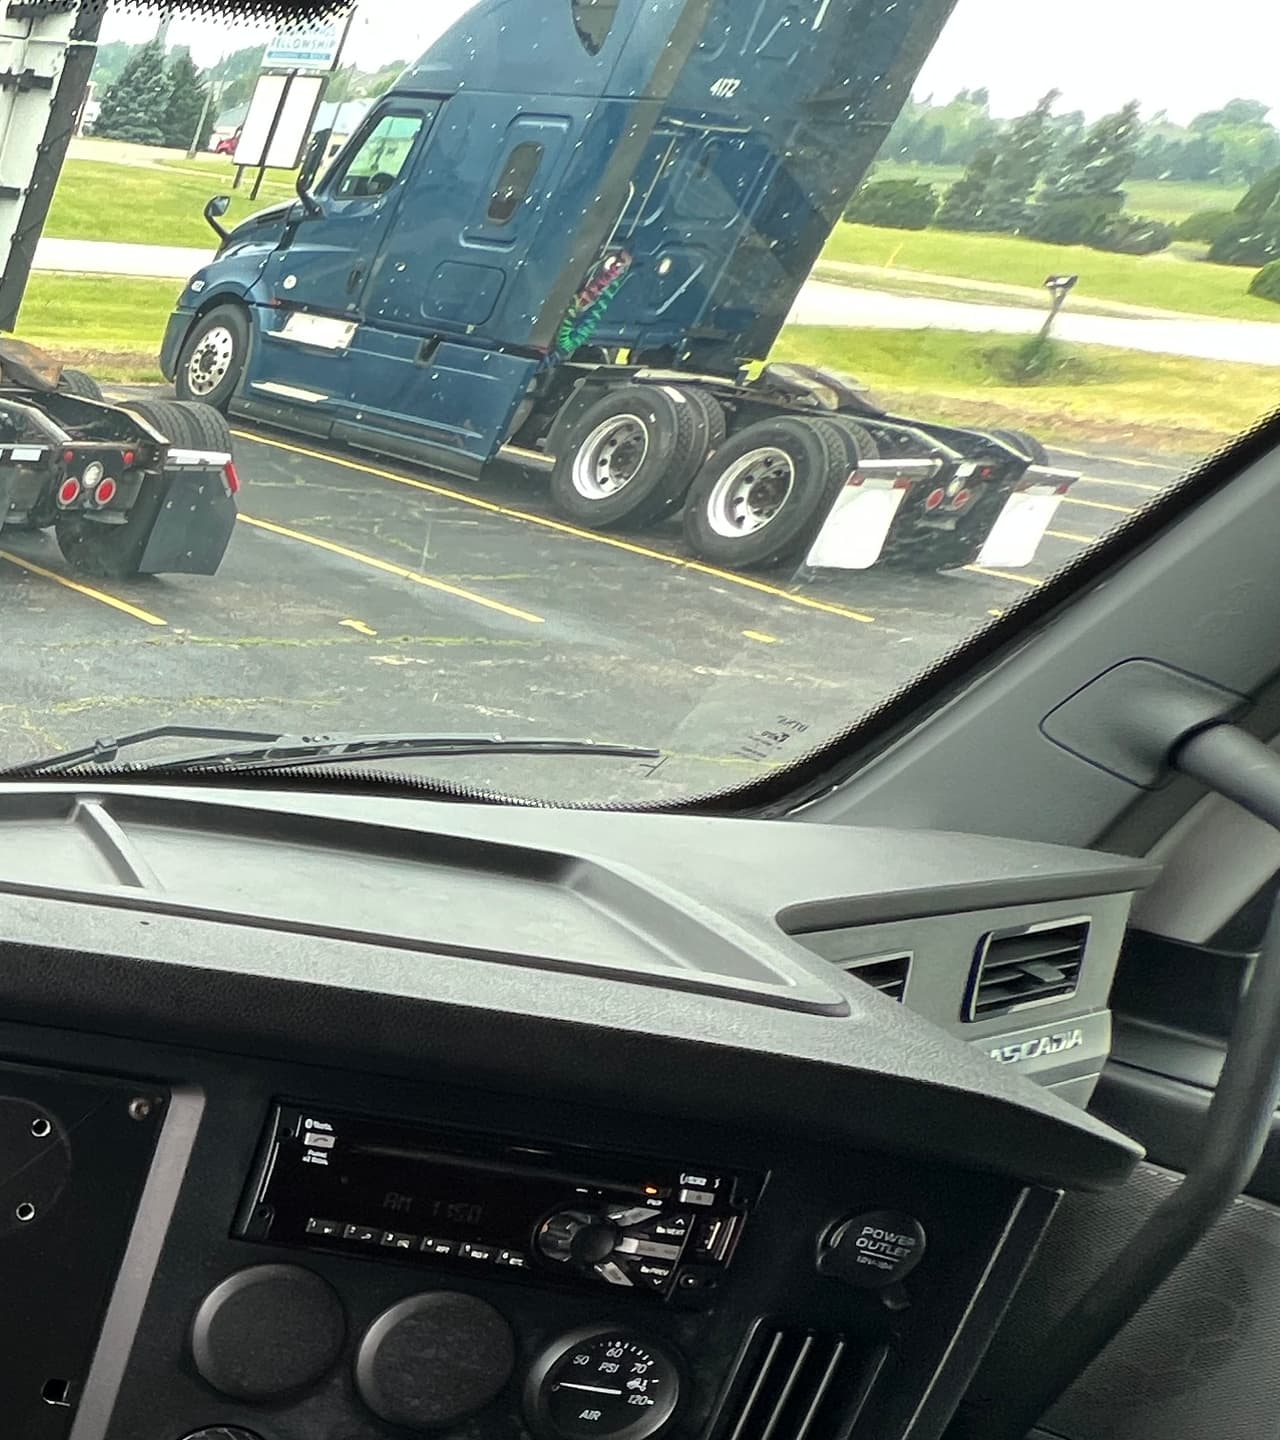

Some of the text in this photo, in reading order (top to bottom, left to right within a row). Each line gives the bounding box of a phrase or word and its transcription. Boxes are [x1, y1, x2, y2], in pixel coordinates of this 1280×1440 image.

[861, 1226, 916, 1246] POWER
[855, 1237, 911, 1256] OUTLET
[598, 1362, 620, 1373] PSI
[630, 1362, 647, 1374] 70
[578, 1409, 602, 1421] AIR
